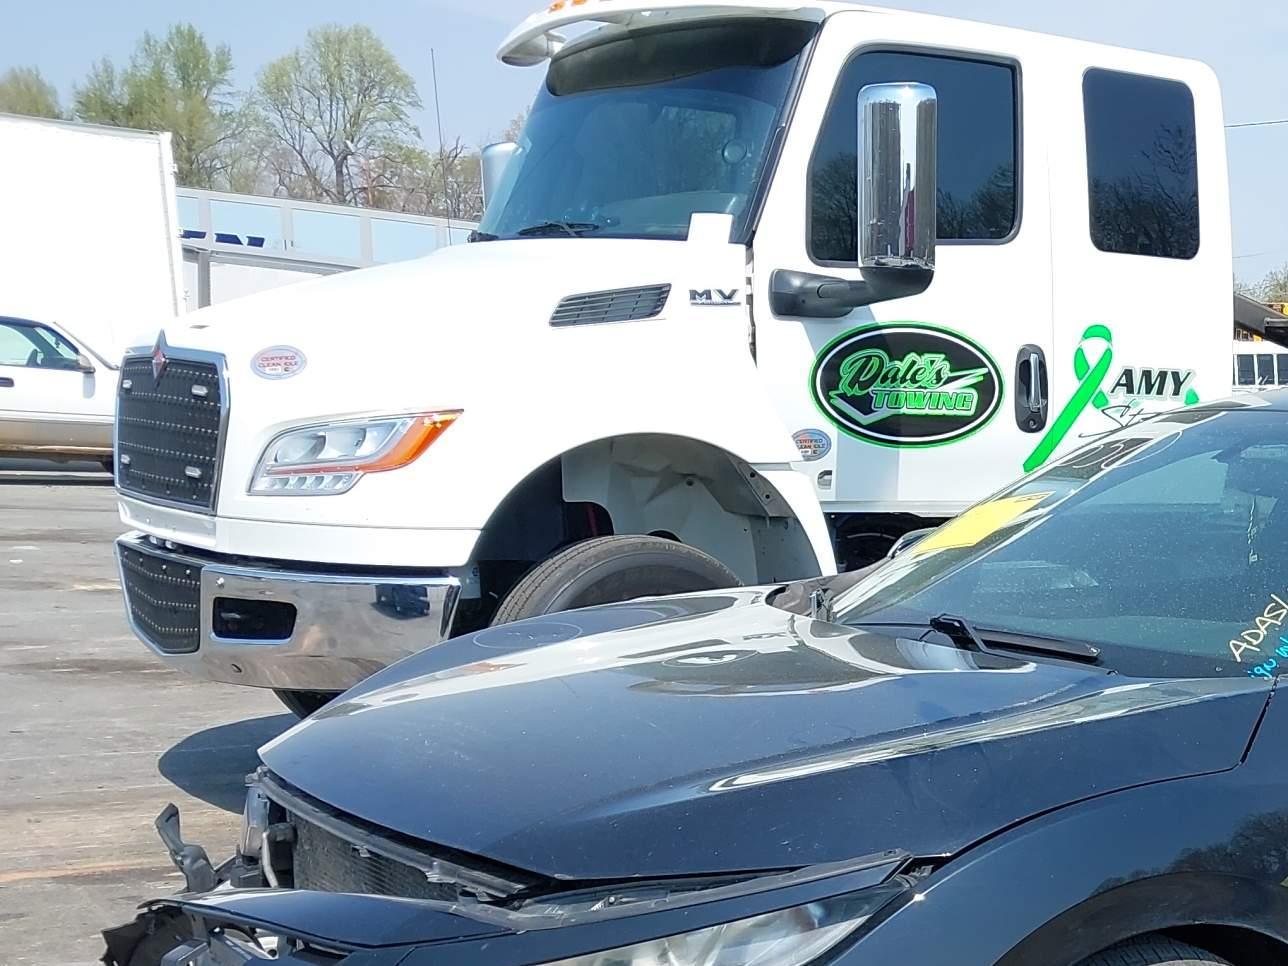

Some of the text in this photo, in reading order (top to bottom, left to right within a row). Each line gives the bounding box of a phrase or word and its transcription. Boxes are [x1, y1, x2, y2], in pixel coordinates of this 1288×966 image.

[689, 288, 740, 301] MV
[842, 350, 949, 392] Dale's
[1109, 367, 1192, 397] AMY
[871, 389, 976, 412] TOWING
